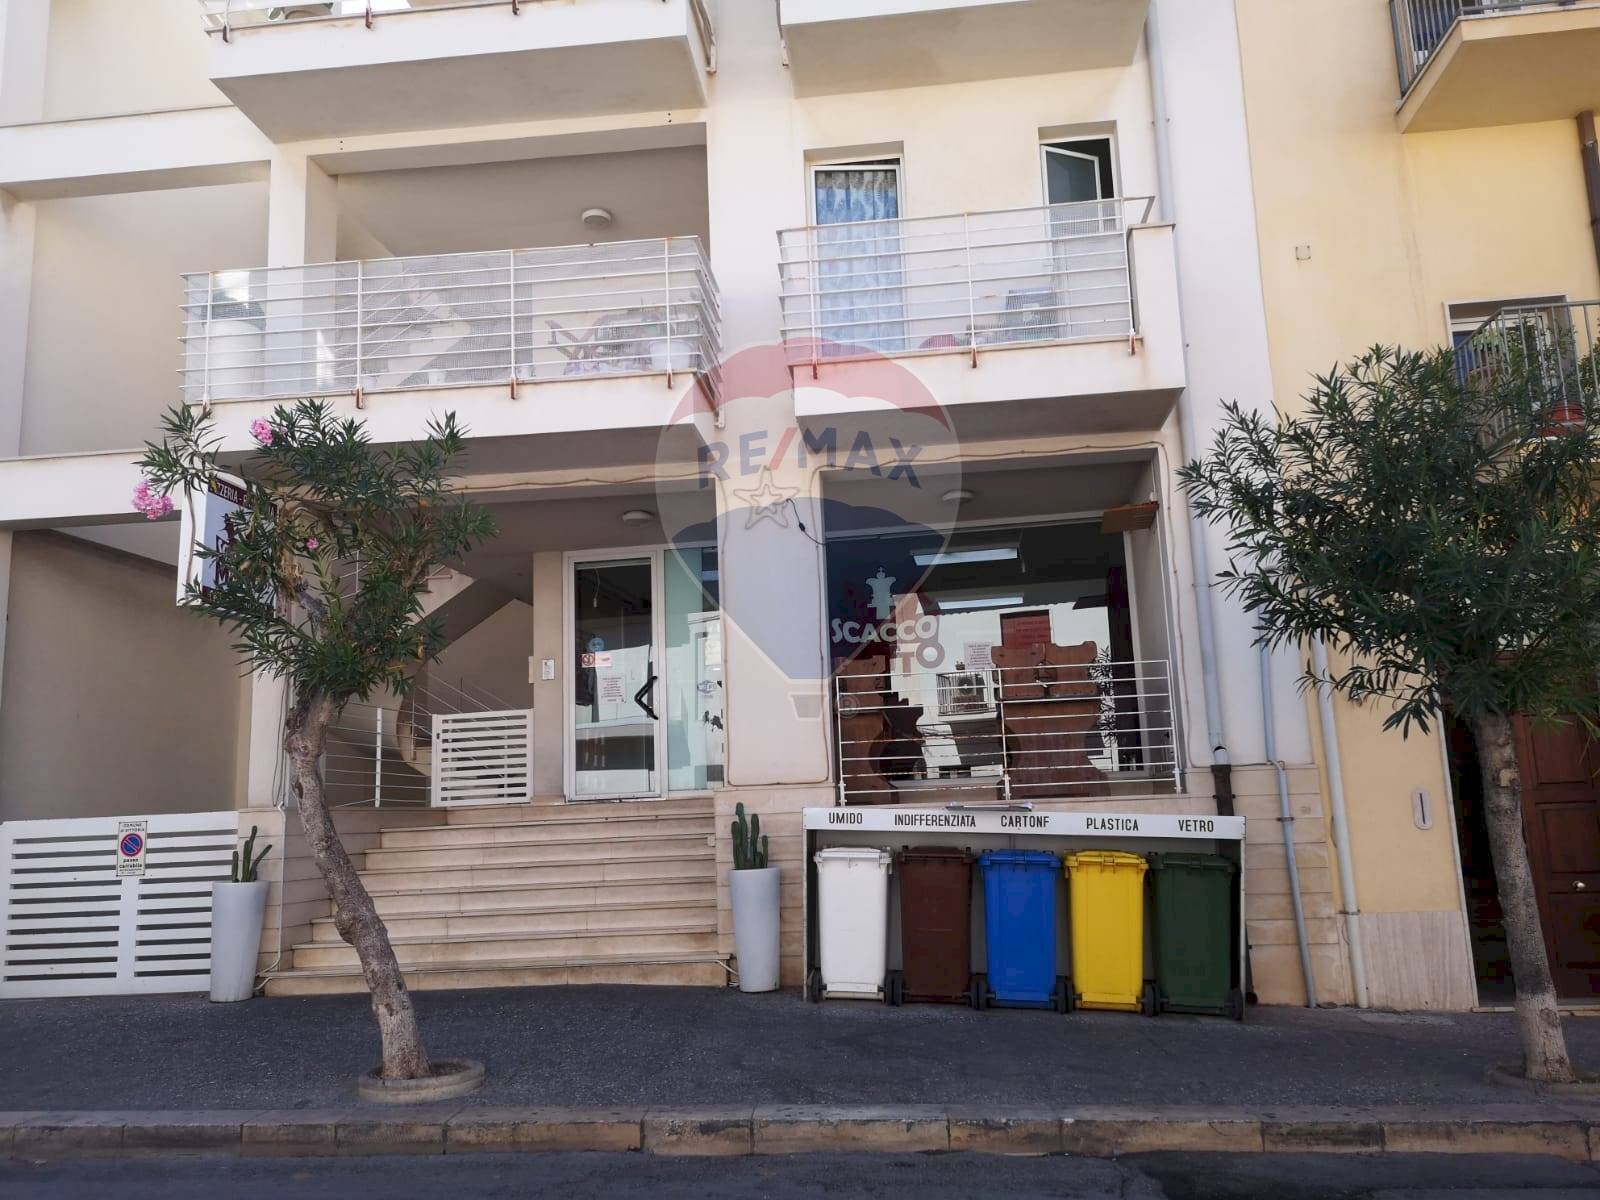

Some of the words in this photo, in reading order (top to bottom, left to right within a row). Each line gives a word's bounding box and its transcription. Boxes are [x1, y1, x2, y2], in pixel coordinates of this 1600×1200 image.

[831, 614, 938, 643] SCACCO
[828, 812, 863, 825] UMIDO
[894, 813, 977, 828] INDIFFERENZIATA
[1086, 817, 1139, 831] PLASTICA
[1178, 819, 1214, 833] VETRO
